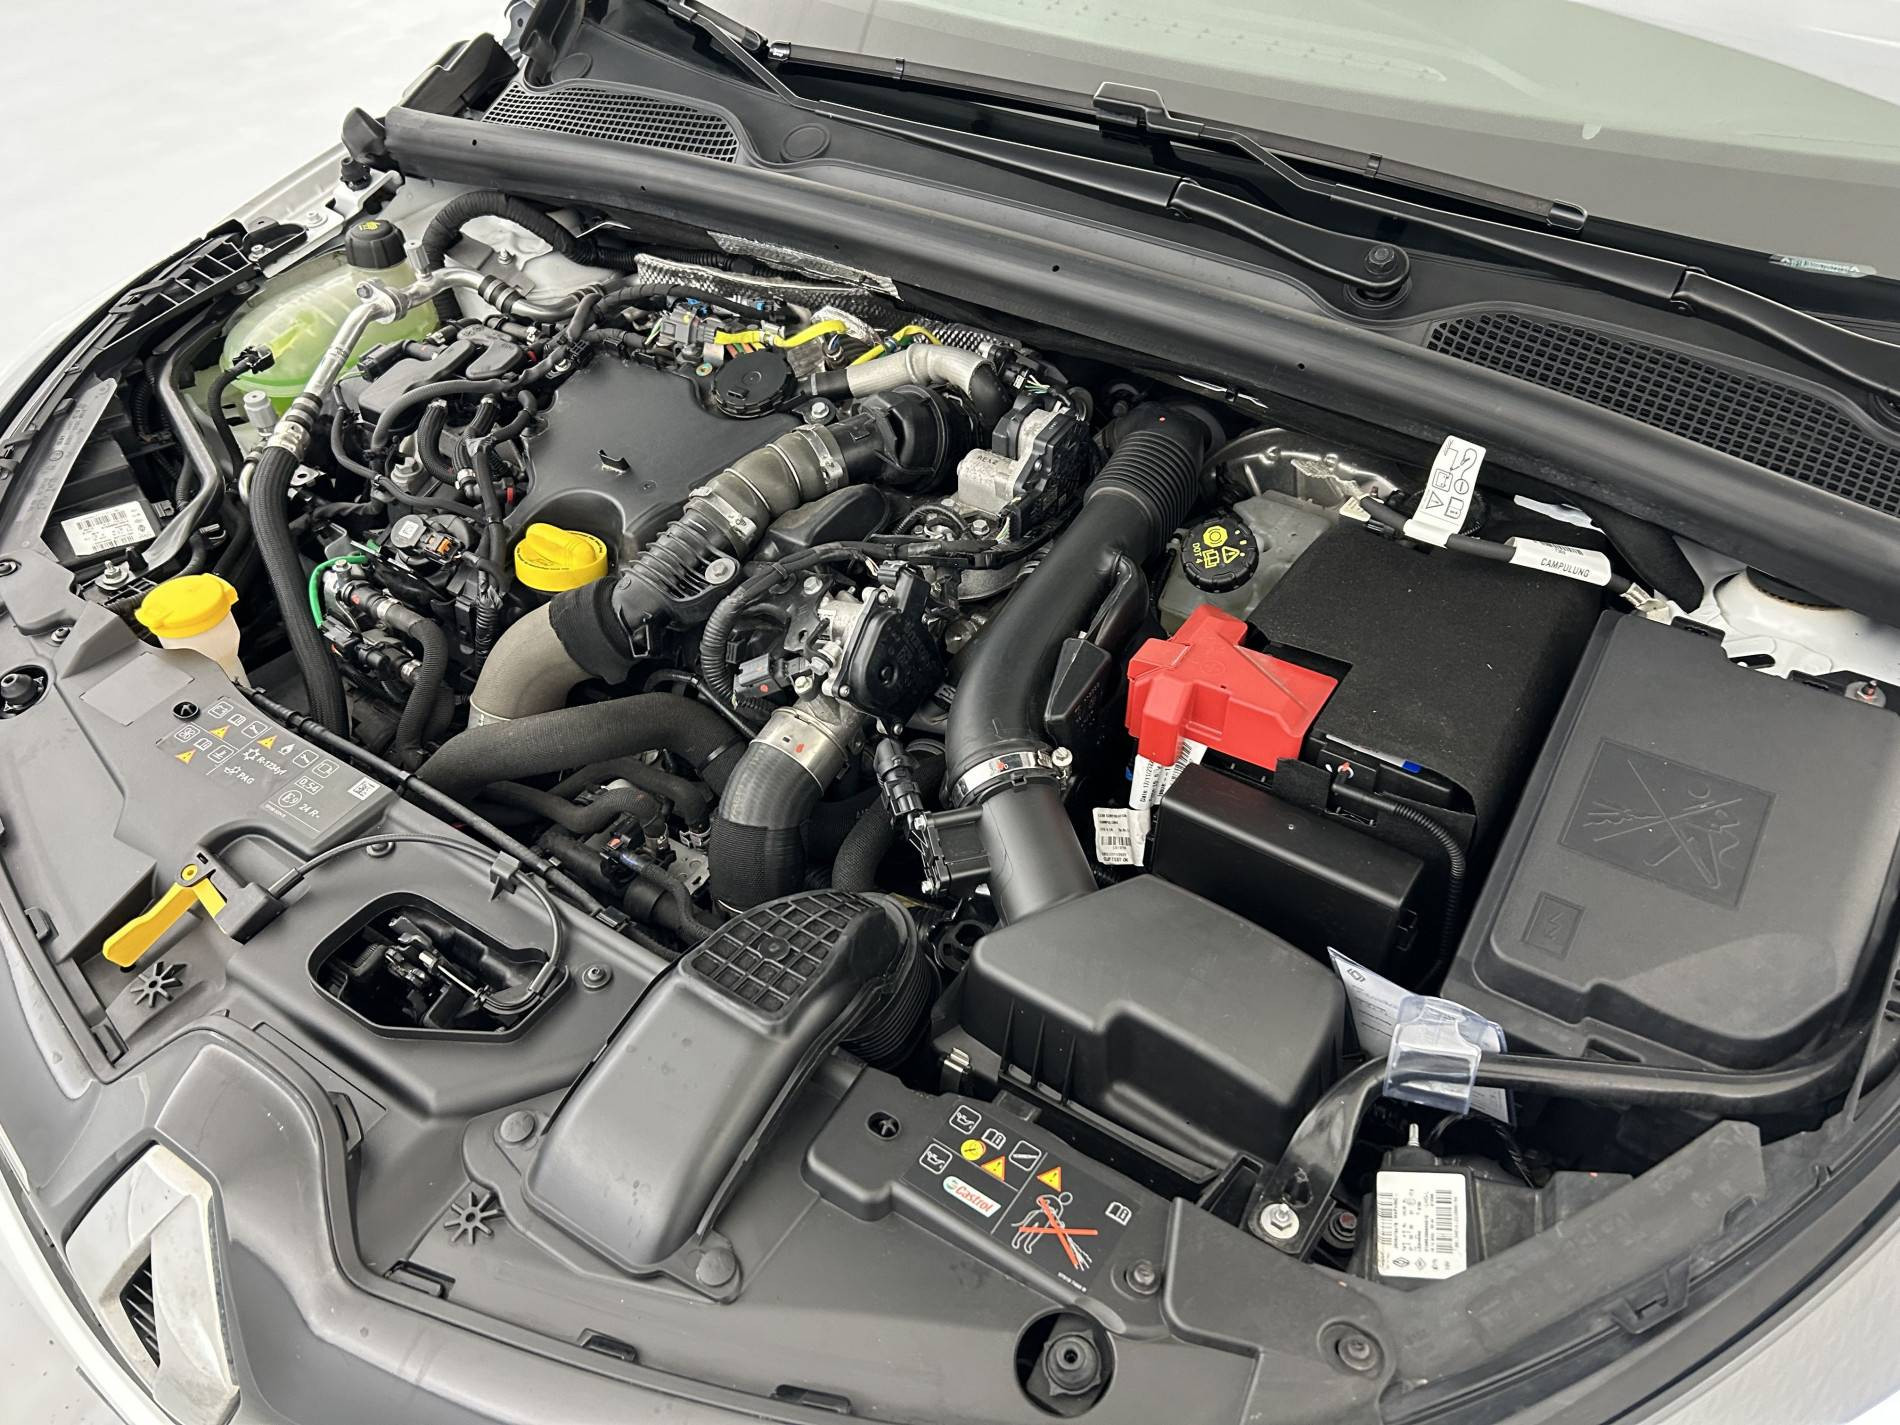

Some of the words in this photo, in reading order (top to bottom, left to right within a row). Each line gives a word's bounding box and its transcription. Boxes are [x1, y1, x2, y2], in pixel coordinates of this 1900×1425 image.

[1192, 542, 1202, 557] DOT
[1540, 557, 1590, 578] CAMPULUNG
[237, 771, 255, 784] PAG
[299, 803, 312, 814] 24
[955, 1186, 994, 1212] Castrol
